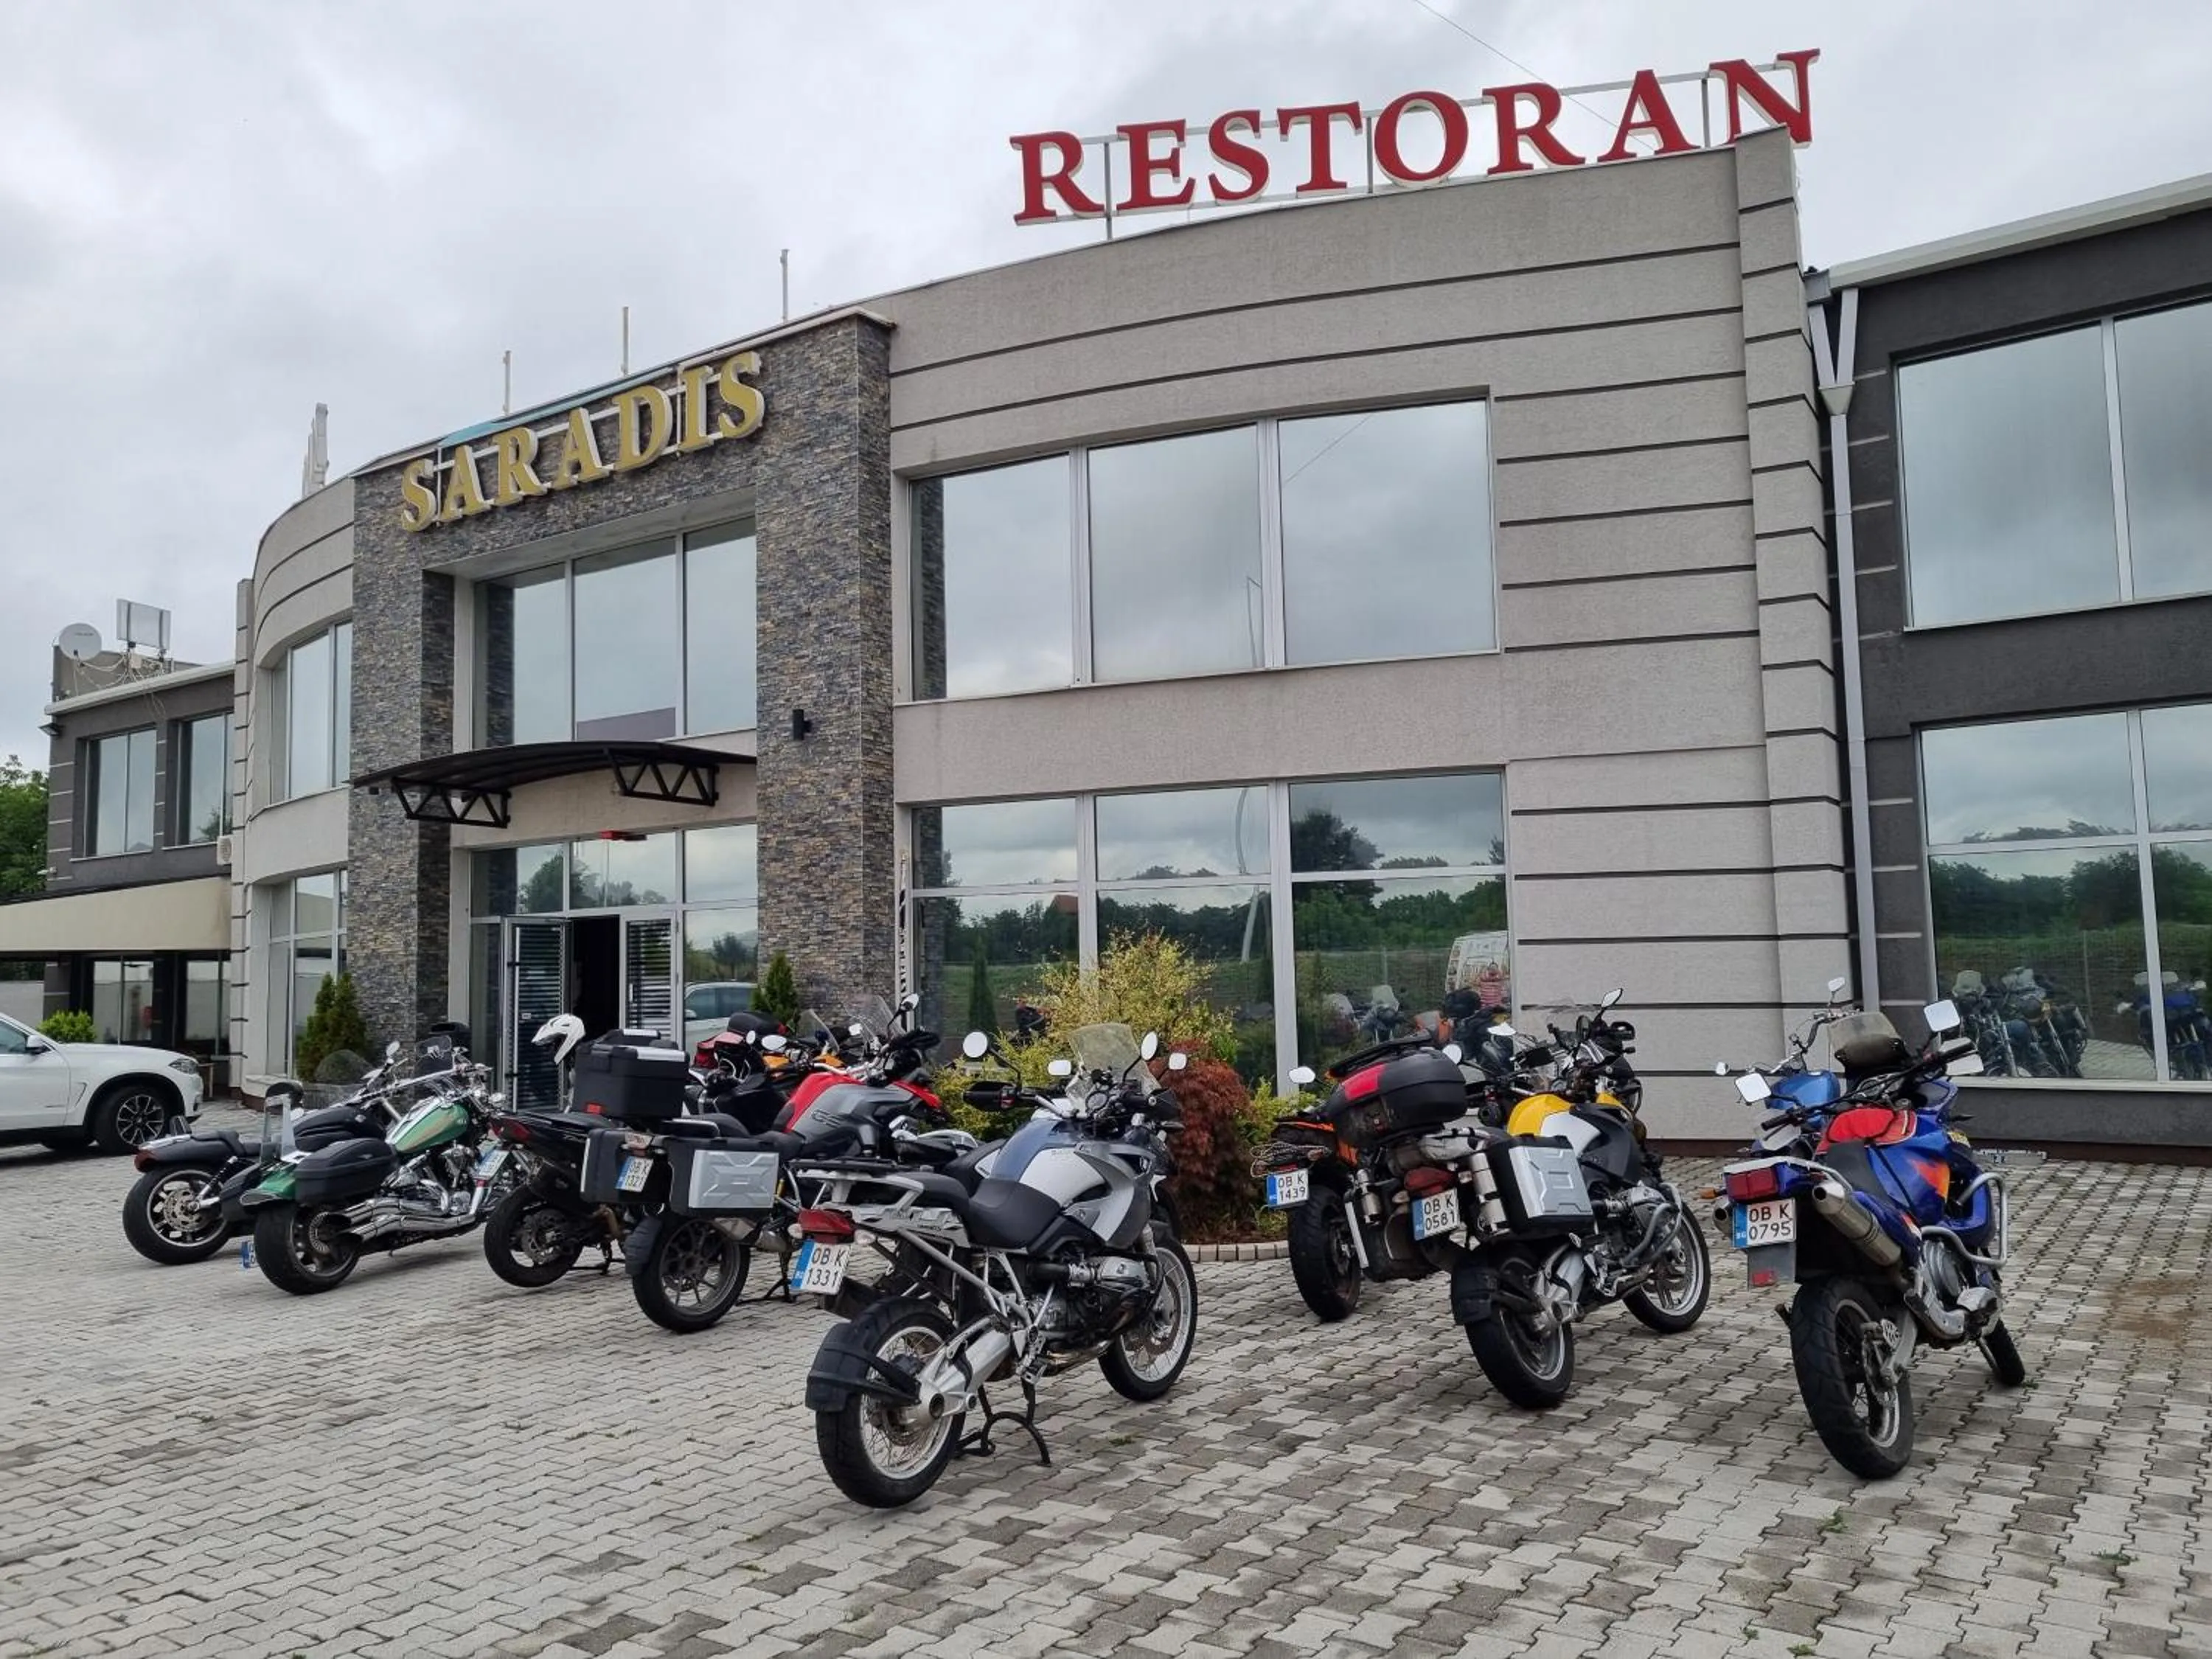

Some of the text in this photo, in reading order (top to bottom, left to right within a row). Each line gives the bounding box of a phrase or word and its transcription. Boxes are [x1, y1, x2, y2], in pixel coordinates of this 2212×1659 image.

[1009, 48, 1822, 226] RESTORAN
[401, 351, 765, 533] SARADIS
[1278, 1173, 1304, 1188] OB K
[1279, 1186, 1306, 1201] 1439
[1424, 1194, 1454, 1215] OB K
[1749, 1203, 1791, 1222] OB K
[1425, 1210, 1455, 1231] 0581
[1749, 1220, 1791, 1240] 0795
[812, 1248, 846, 1267] OB K
[806, 1267, 839, 1287] 1331
